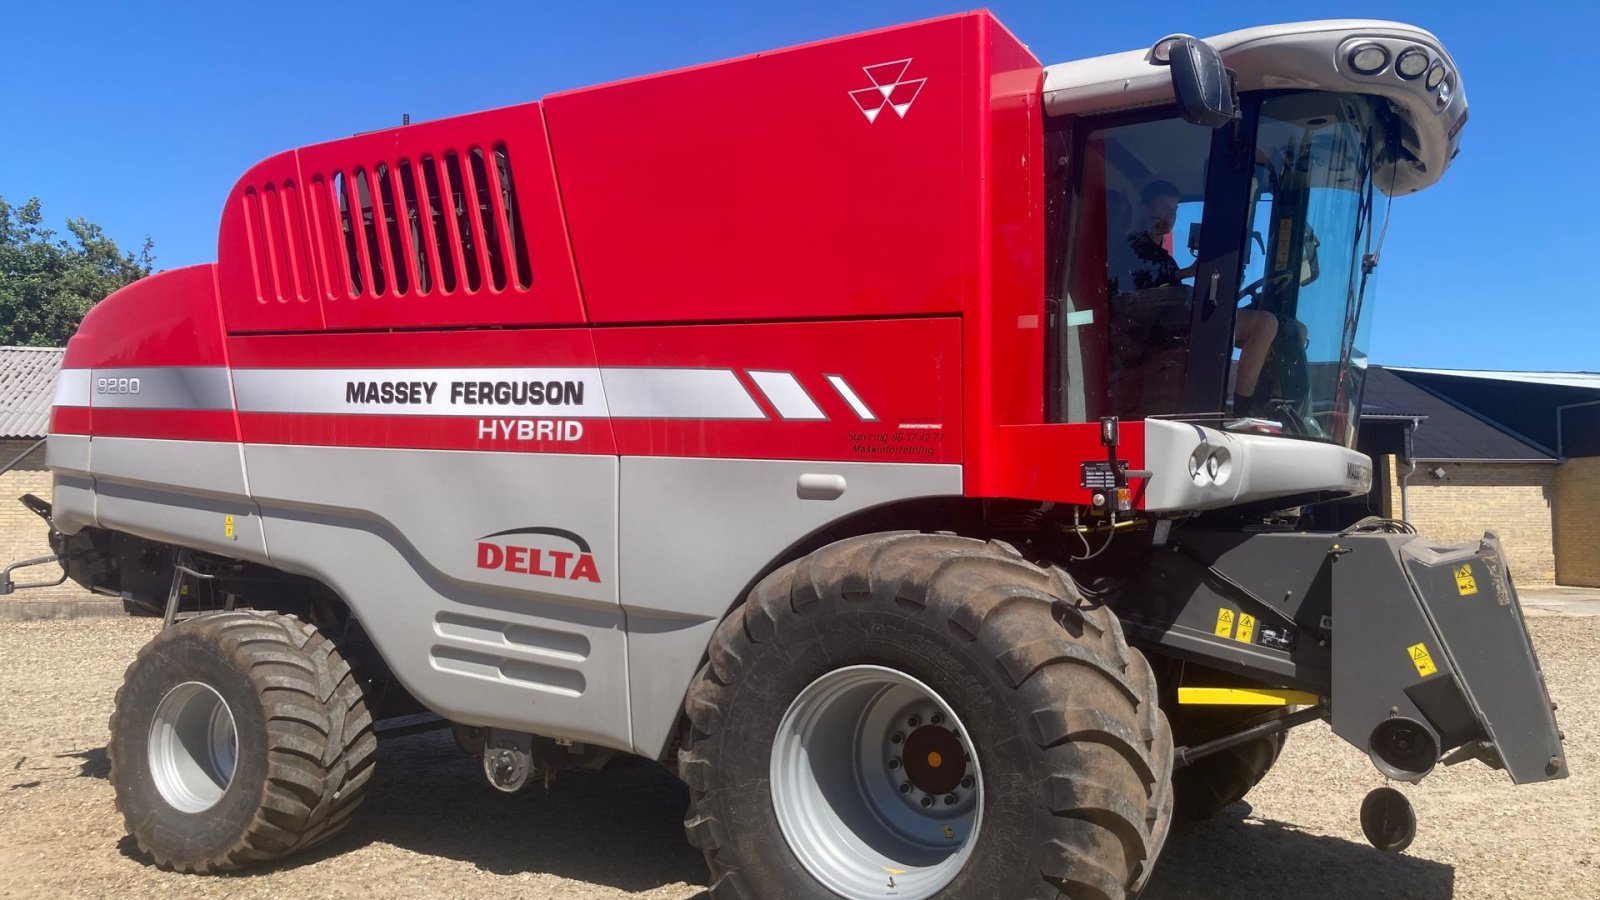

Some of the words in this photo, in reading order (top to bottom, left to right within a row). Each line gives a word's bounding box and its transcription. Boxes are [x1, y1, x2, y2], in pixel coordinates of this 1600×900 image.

[98, 377, 140, 394] 9280
[346, 381, 438, 404] MASSEY
[450, 381, 584, 405] FERGUSON
[478, 419, 583, 441] HYBRID
[477, 542, 601, 583] DELTA
